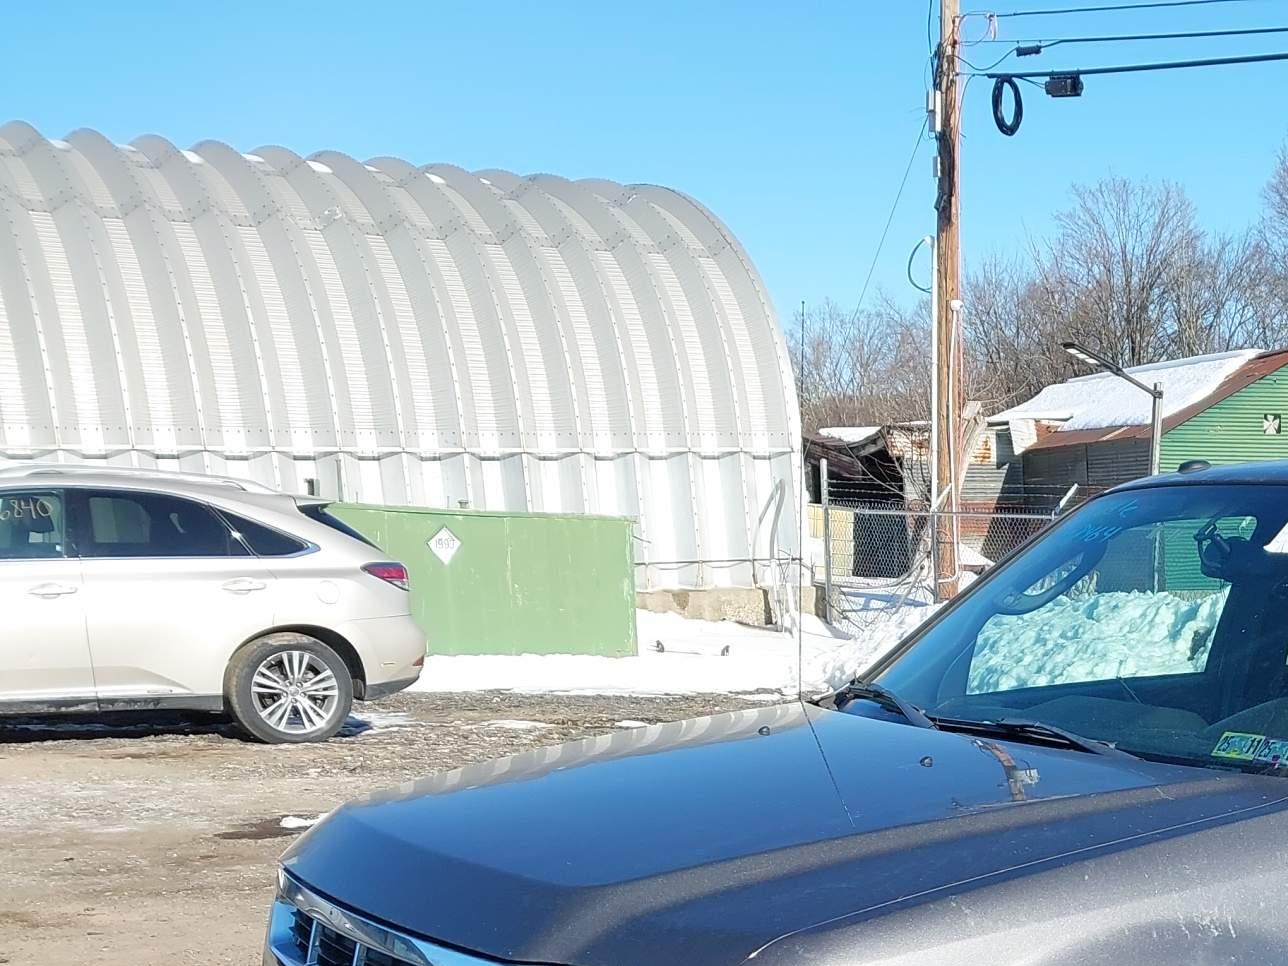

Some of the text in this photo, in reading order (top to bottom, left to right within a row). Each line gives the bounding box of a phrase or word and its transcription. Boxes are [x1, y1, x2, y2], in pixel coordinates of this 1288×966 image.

[1217, 735, 1263, 755] 25 11
[1258, 740, 1276, 758] 25
